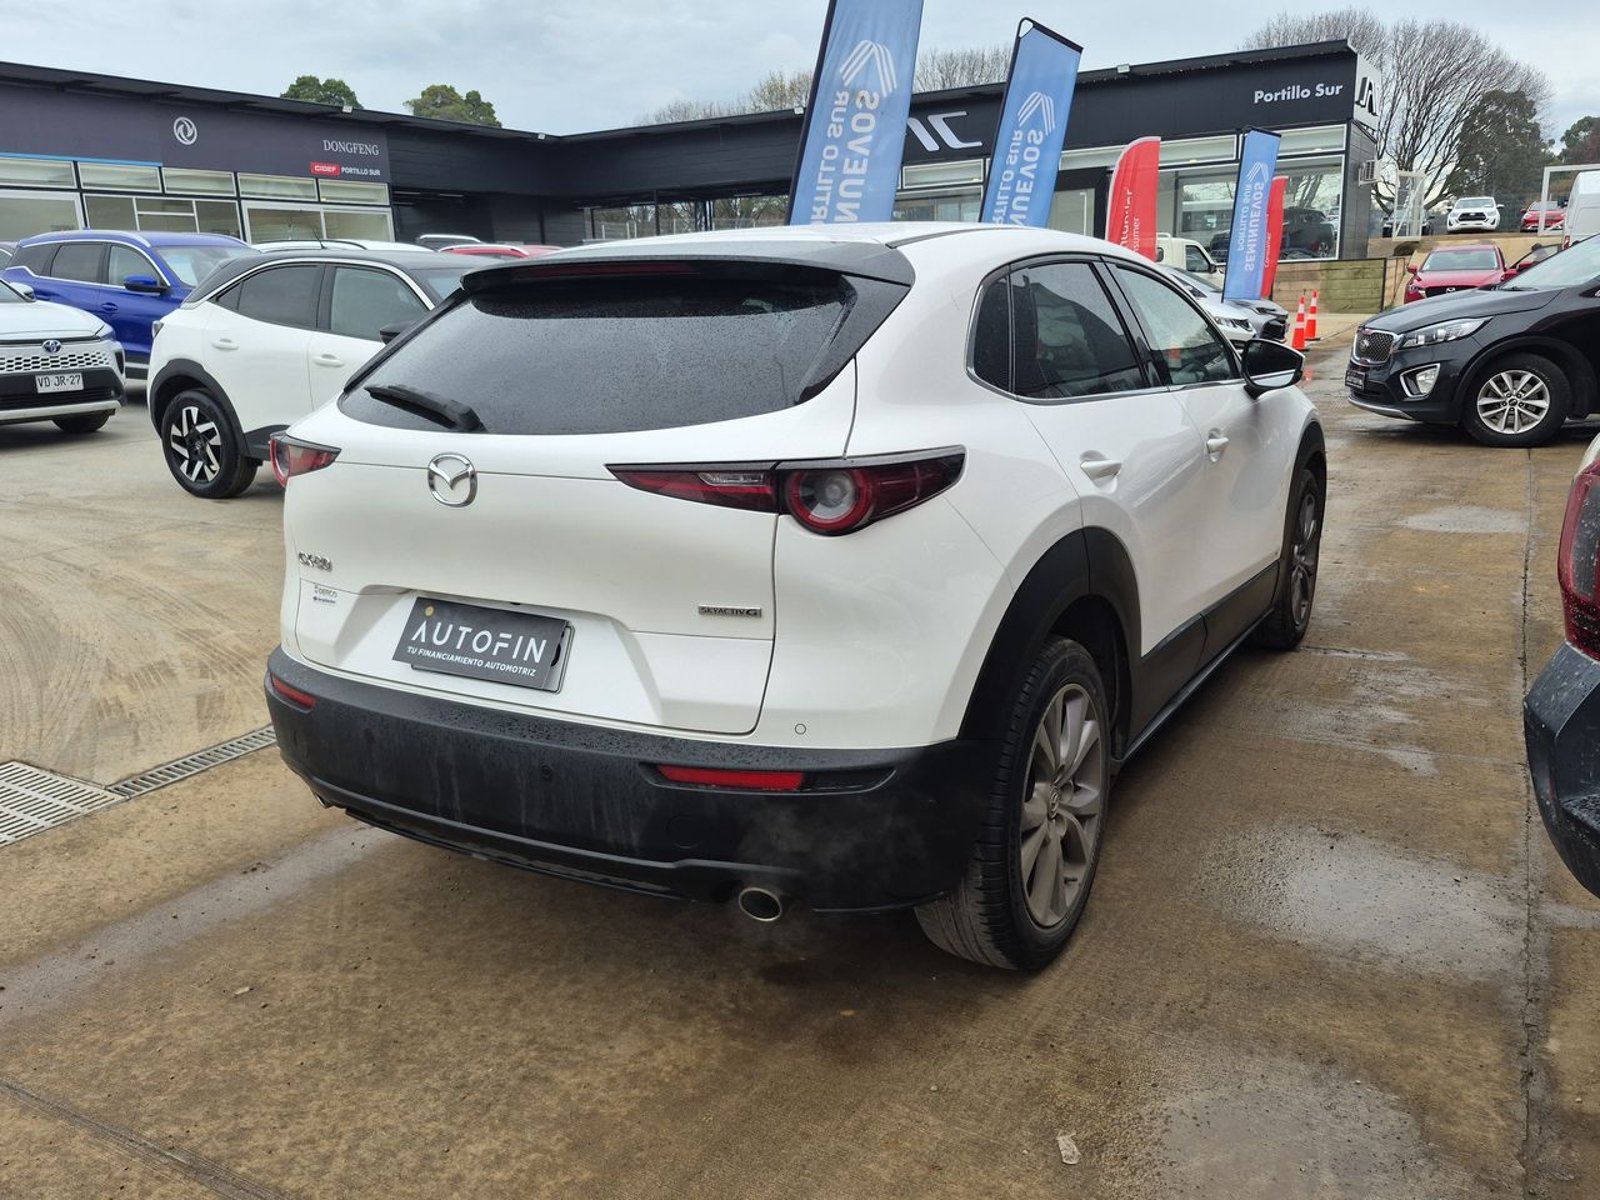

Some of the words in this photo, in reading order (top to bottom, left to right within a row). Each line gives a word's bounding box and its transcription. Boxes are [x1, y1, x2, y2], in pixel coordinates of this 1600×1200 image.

[1254, 85, 1311, 103] Portillo
[1315, 83, 1343, 97] Sur
[323, 139, 380, 155] DONGFENG
[341, 166, 368, 175] PORTILLO
[411, 620, 547, 663] AUTOFIN
[407, 646, 418, 654] TU
[418, 648, 484, 667] FINANCIAMIENTO
[484, 661, 537, 677] AUTOMOTRIZ
